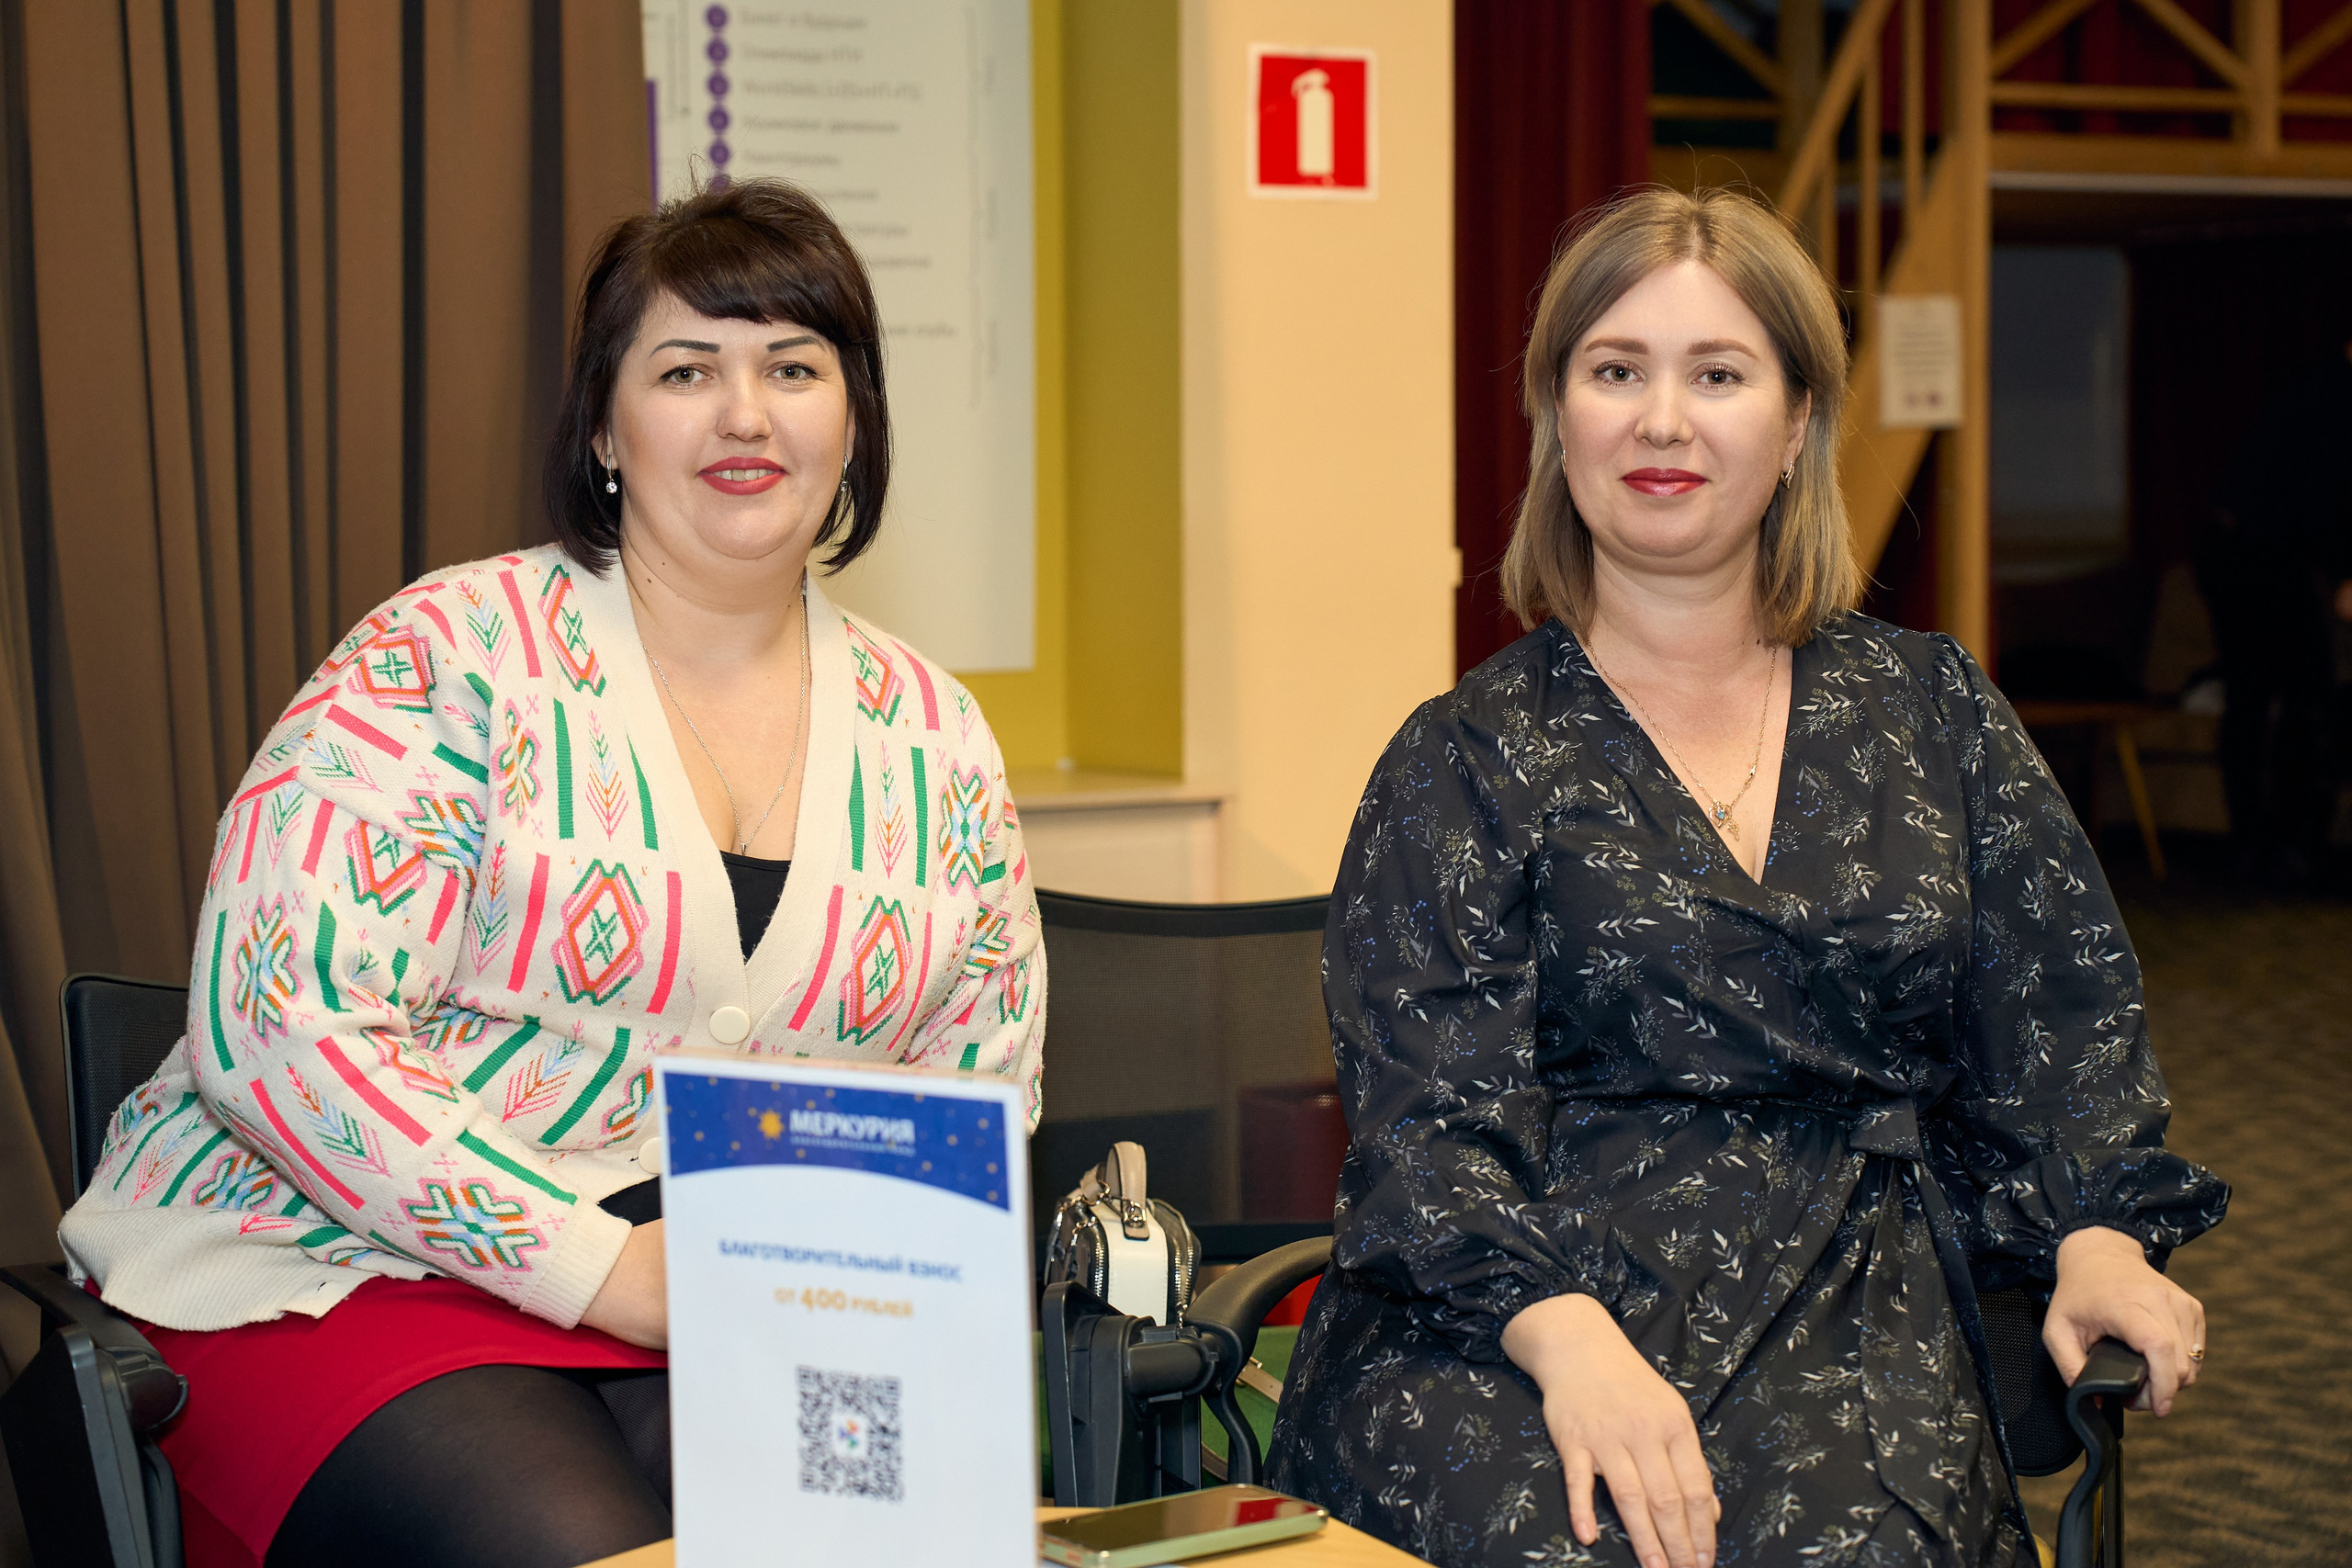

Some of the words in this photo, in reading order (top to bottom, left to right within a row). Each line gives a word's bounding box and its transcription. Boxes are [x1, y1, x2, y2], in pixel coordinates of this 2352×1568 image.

[718, 1238, 903, 1273] БЛАГОТВОРИТЕЛЬНЫЙ
[909, 1259, 963, 1283] ВЗНОС
[800, 1286, 847, 1313] 400
[851, 1294, 914, 1318] РУБЛЕЙ
